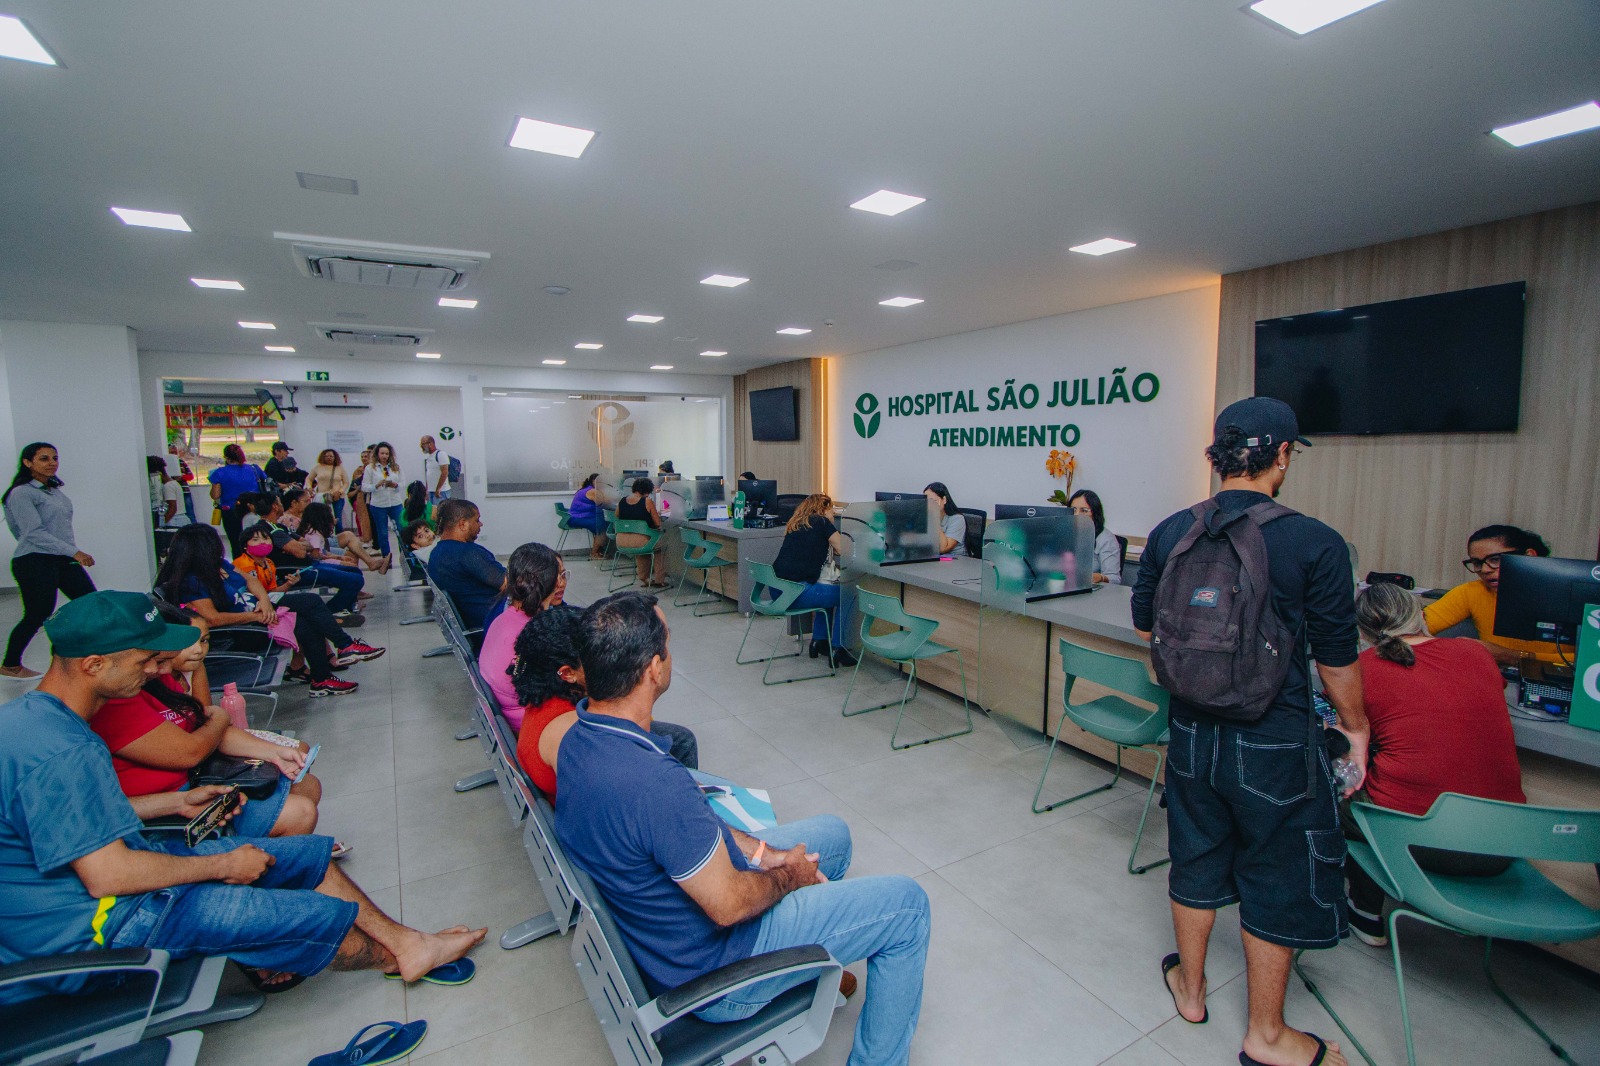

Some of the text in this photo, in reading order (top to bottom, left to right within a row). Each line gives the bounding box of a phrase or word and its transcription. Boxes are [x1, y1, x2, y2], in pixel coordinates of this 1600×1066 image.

[888, 366, 1160, 417] HOSPITAL SÃO JULIÃO
[928, 423, 1081, 447] ATENDIMENTO
[734, 507, 744, 520] 04
